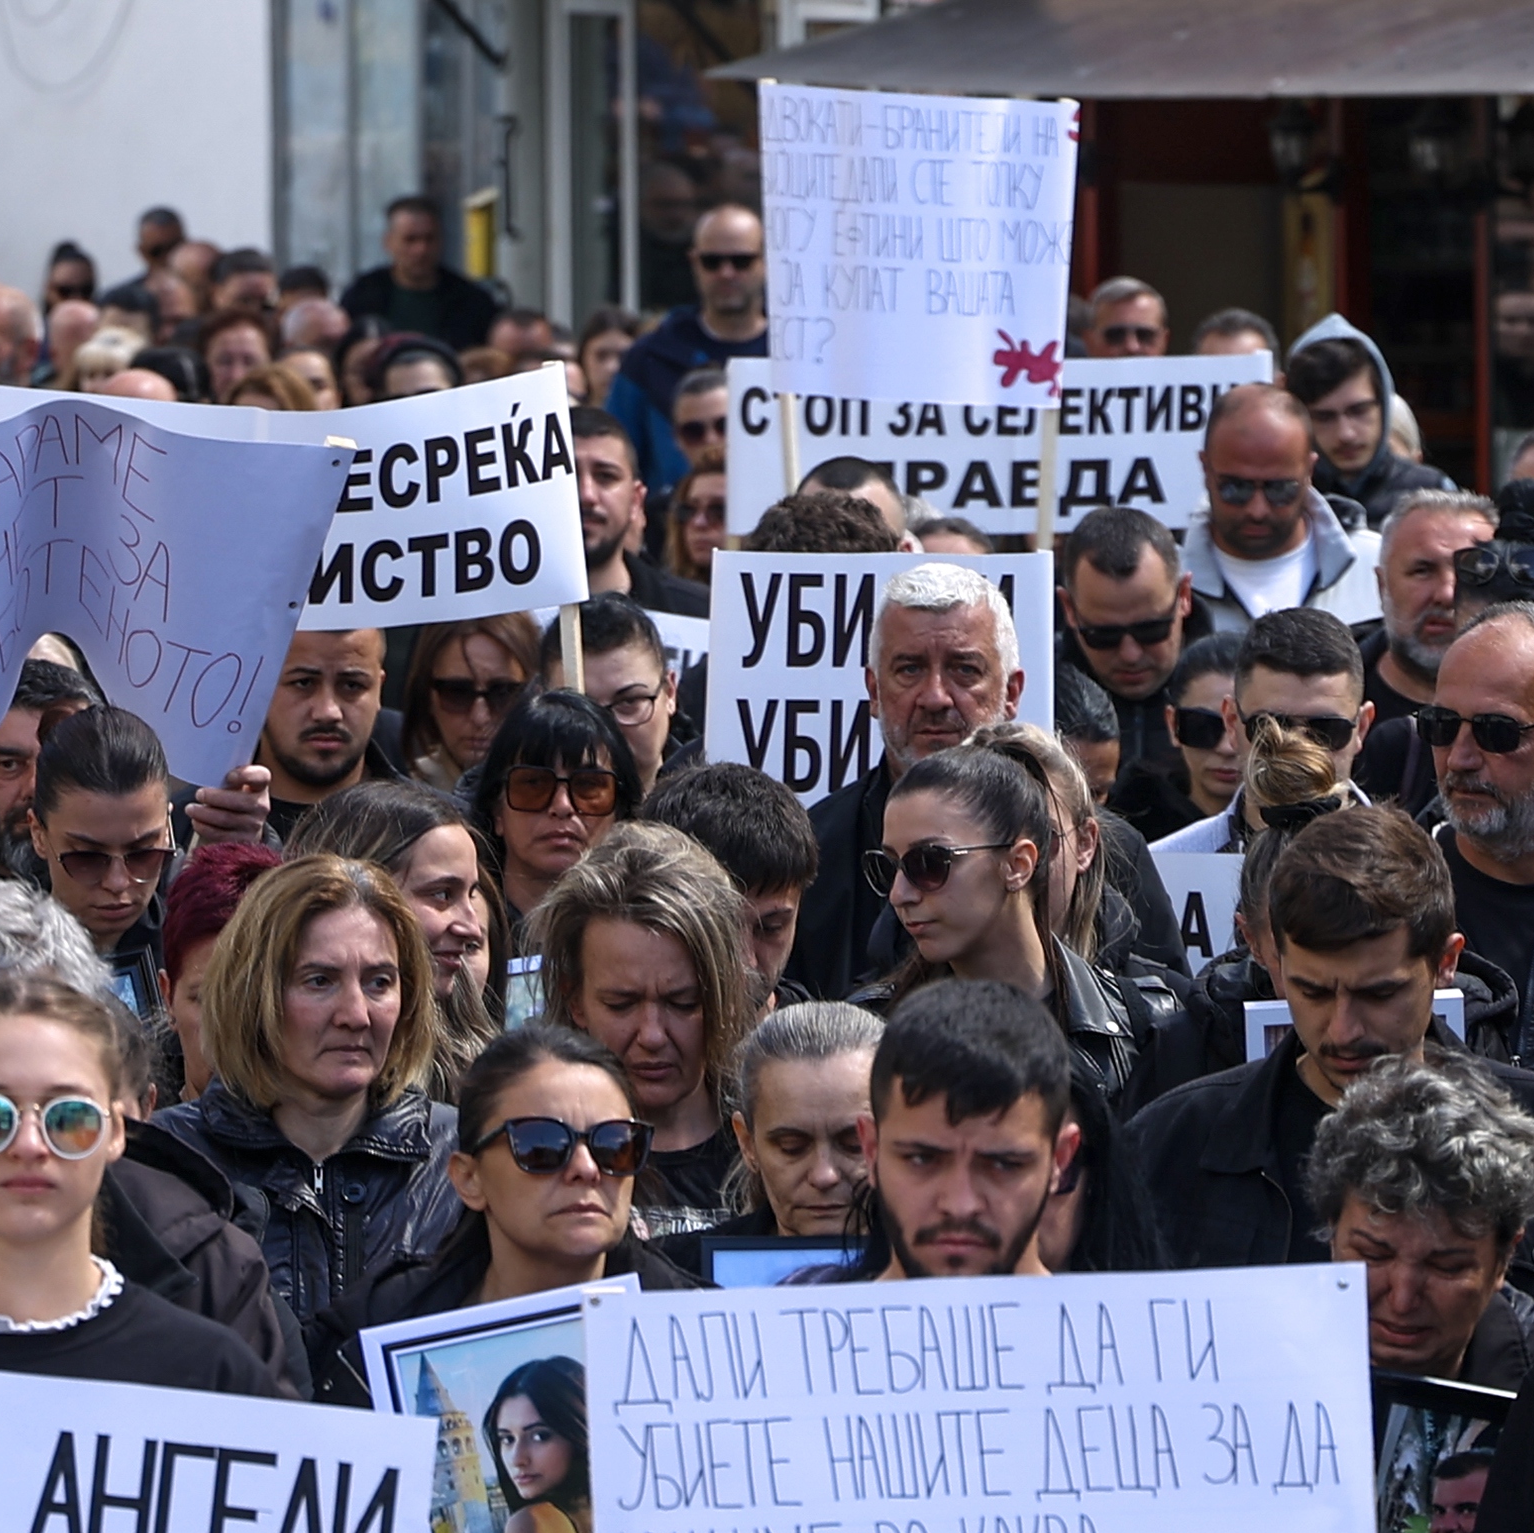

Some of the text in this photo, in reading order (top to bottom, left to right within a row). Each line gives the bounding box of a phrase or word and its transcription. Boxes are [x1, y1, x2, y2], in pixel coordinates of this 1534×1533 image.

[1032, 115, 1060, 157] НА
[939, 216, 992, 264] ШТО
[819, 263, 905, 314] КУПАТ
[926, 267, 1016, 317] ВАШАТА
[741, 386, 868, 437] СОП
[335, 402, 573, 513] ЕСРЕЌА
[107, 514, 171, 623] ЗА
[308, 519, 542, 603] ИСТВО
[737, 699, 872, 793] УБИ
[614, 1299, 1221, 1415] ДАЛИ ТРЕБАШЕ ДА ГИ
[617, 1400, 1342, 1512] УБИЕТЕ НАШИТЕ ДЕЦА ЗА ДА
